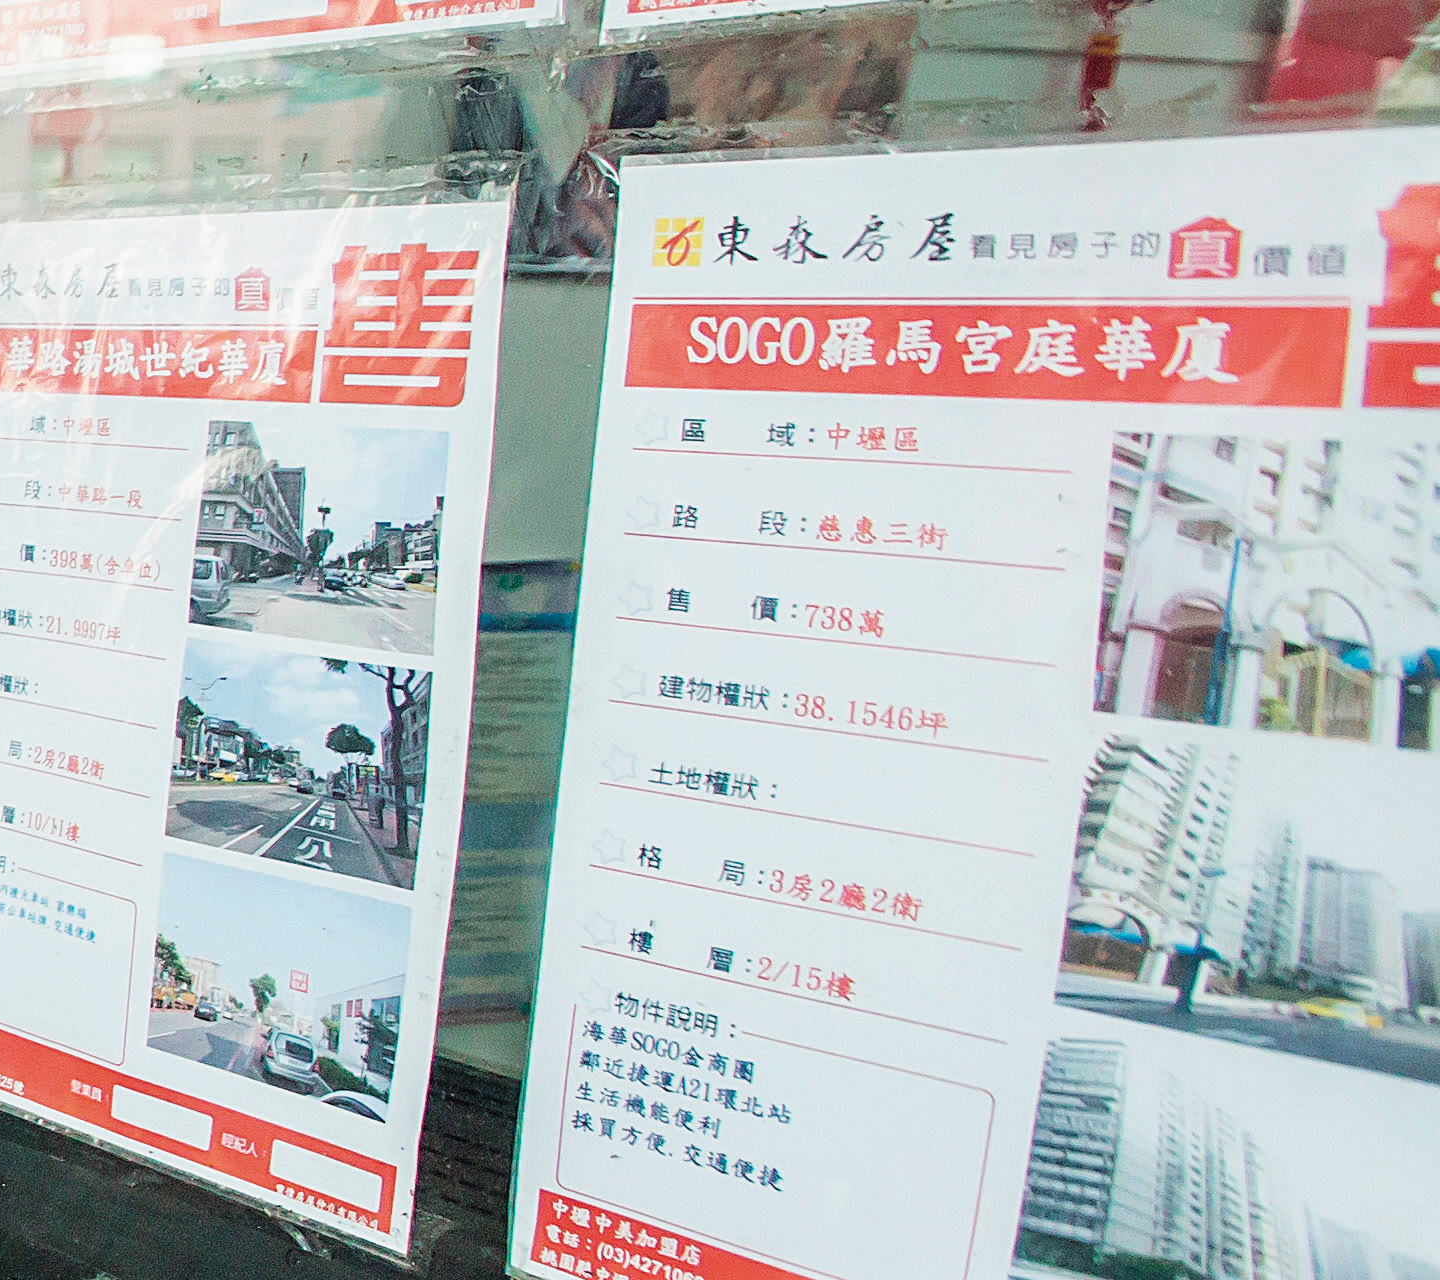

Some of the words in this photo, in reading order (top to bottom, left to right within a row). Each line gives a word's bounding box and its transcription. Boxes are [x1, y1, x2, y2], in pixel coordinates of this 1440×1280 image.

[714, 211, 959, 266] 東森房屋
[319, 243, 479, 407] 售
[686, 315, 1239, 384] SOGO羅馬宮庭華廈
[574, 1081, 722, 1140] 生活機能便利
[552, 1199, 701, 1266] 中壢中美加盟店
